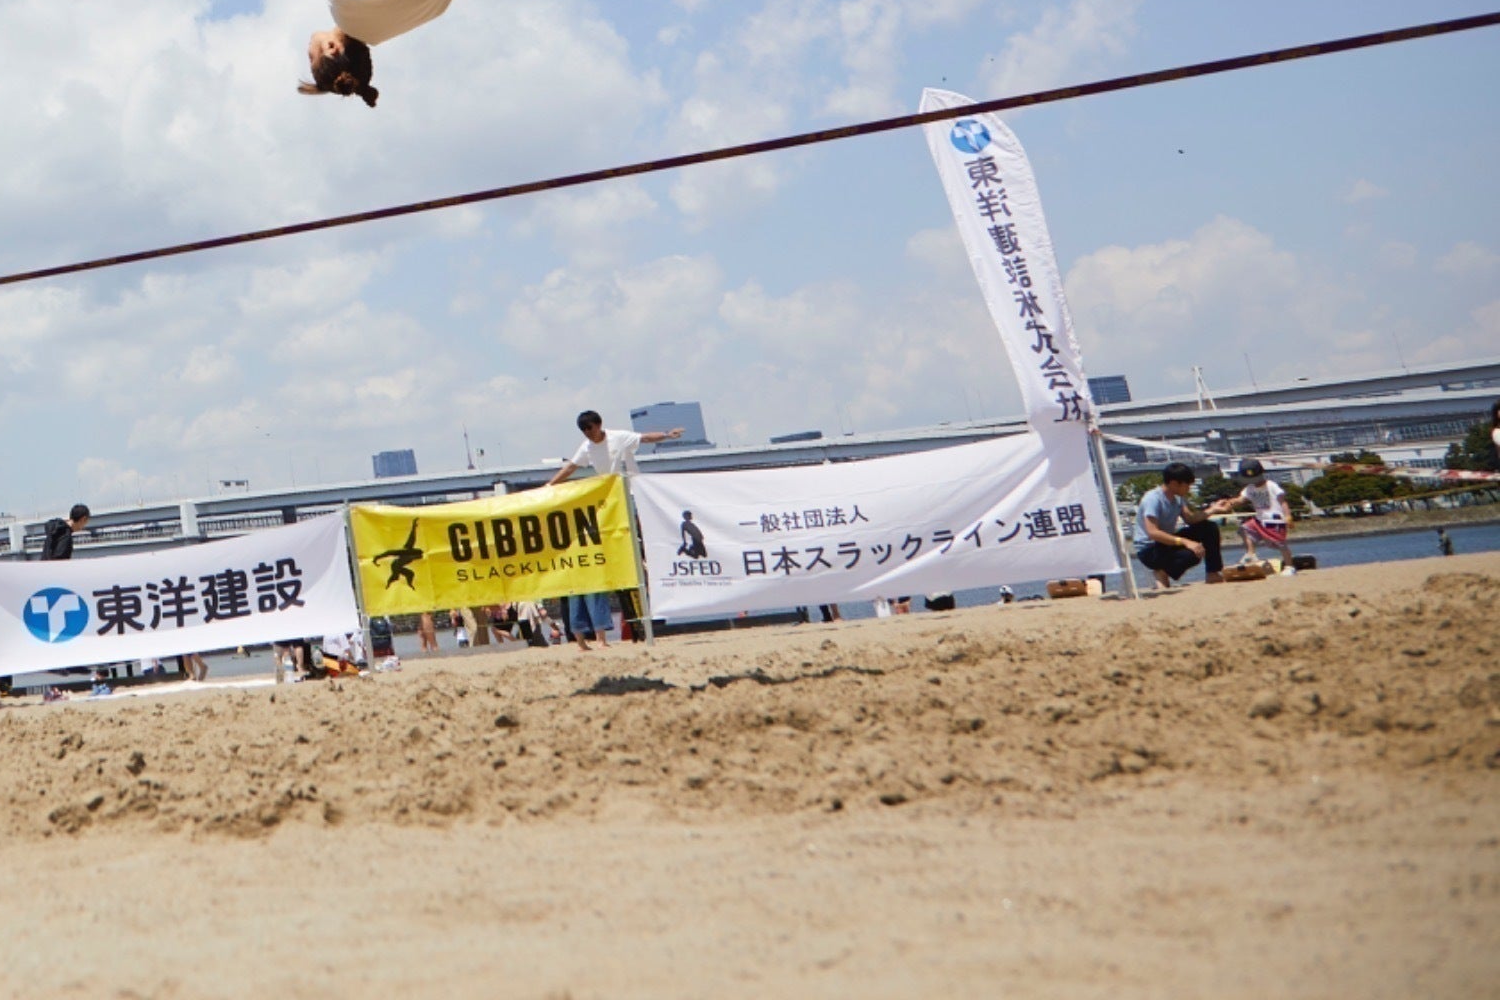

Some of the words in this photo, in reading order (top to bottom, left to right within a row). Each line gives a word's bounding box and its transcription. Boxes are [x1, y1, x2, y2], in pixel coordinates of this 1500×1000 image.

[448, 505, 602, 563] GIBBON
[739, 504, 869, 533] 一般社団法人
[743, 503, 1091, 576] 日本スラックライン連盟
[456, 553, 606, 582] SLACKLINES
[668, 560, 722, 577] JSFED
[92, 557, 305, 635] 東洋建設
